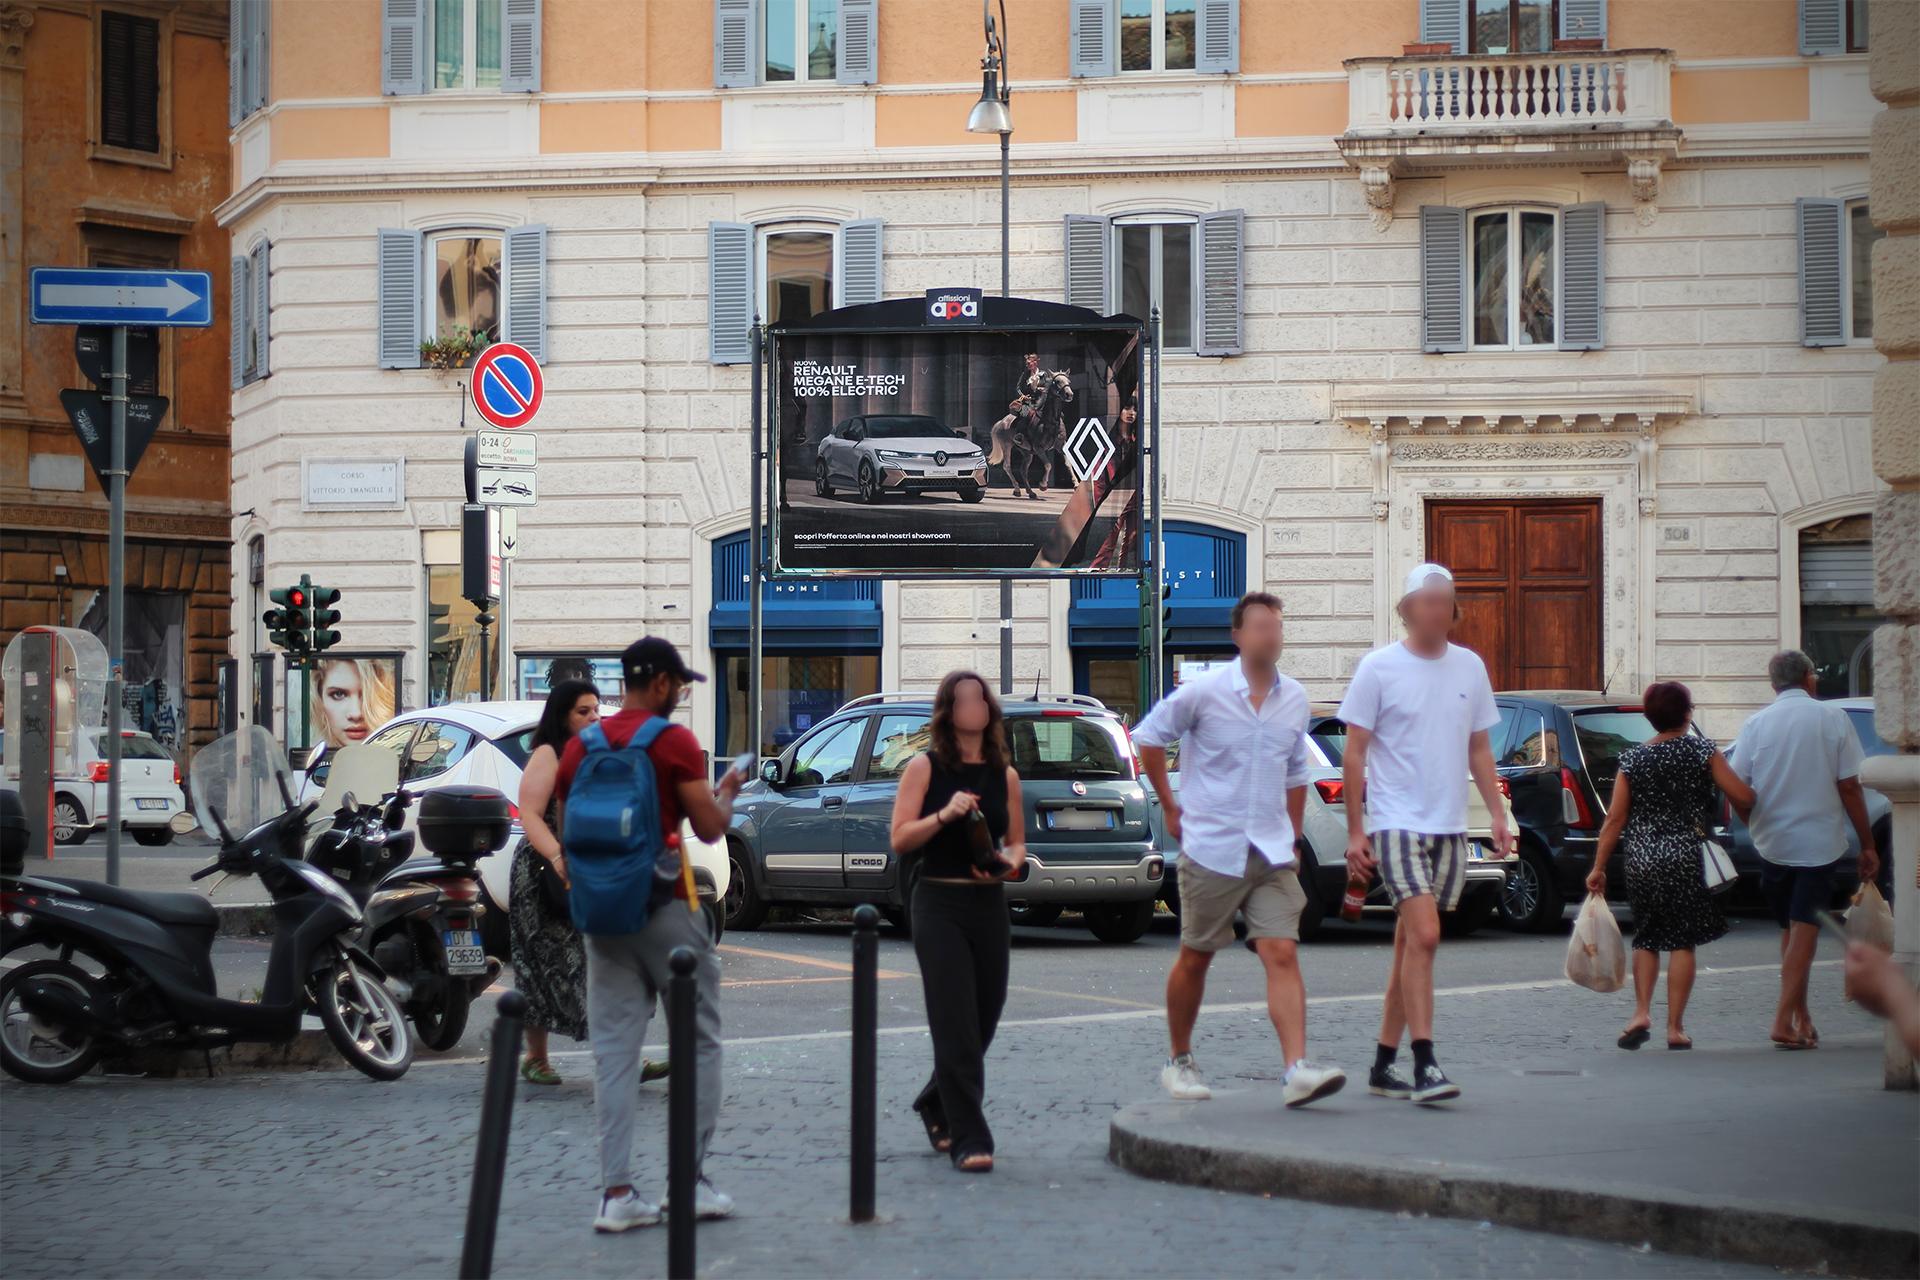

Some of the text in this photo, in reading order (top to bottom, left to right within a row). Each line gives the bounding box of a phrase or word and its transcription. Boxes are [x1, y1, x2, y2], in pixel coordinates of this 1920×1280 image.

[937, 294, 971, 302] affissioni
[930, 301, 978, 321] apa
[793, 365, 857, 376] RENAULT
[793, 374, 906, 386] MEGANE E-TECH
[793, 385, 899, 397] 100% ELECTRIC
[340, 472, 365, 480] CORSO
[312, 487, 346, 495] VITTORIO
[350, 486, 384, 495] EMANUELE
[794, 532, 818, 541] scopri
[847, 532, 871, 540] online
[876, 532, 889, 540] nei
[889, 532, 911, 540] nostri
[911, 532, 951, 540] showroom
[448, 950, 483, 963] 29639
